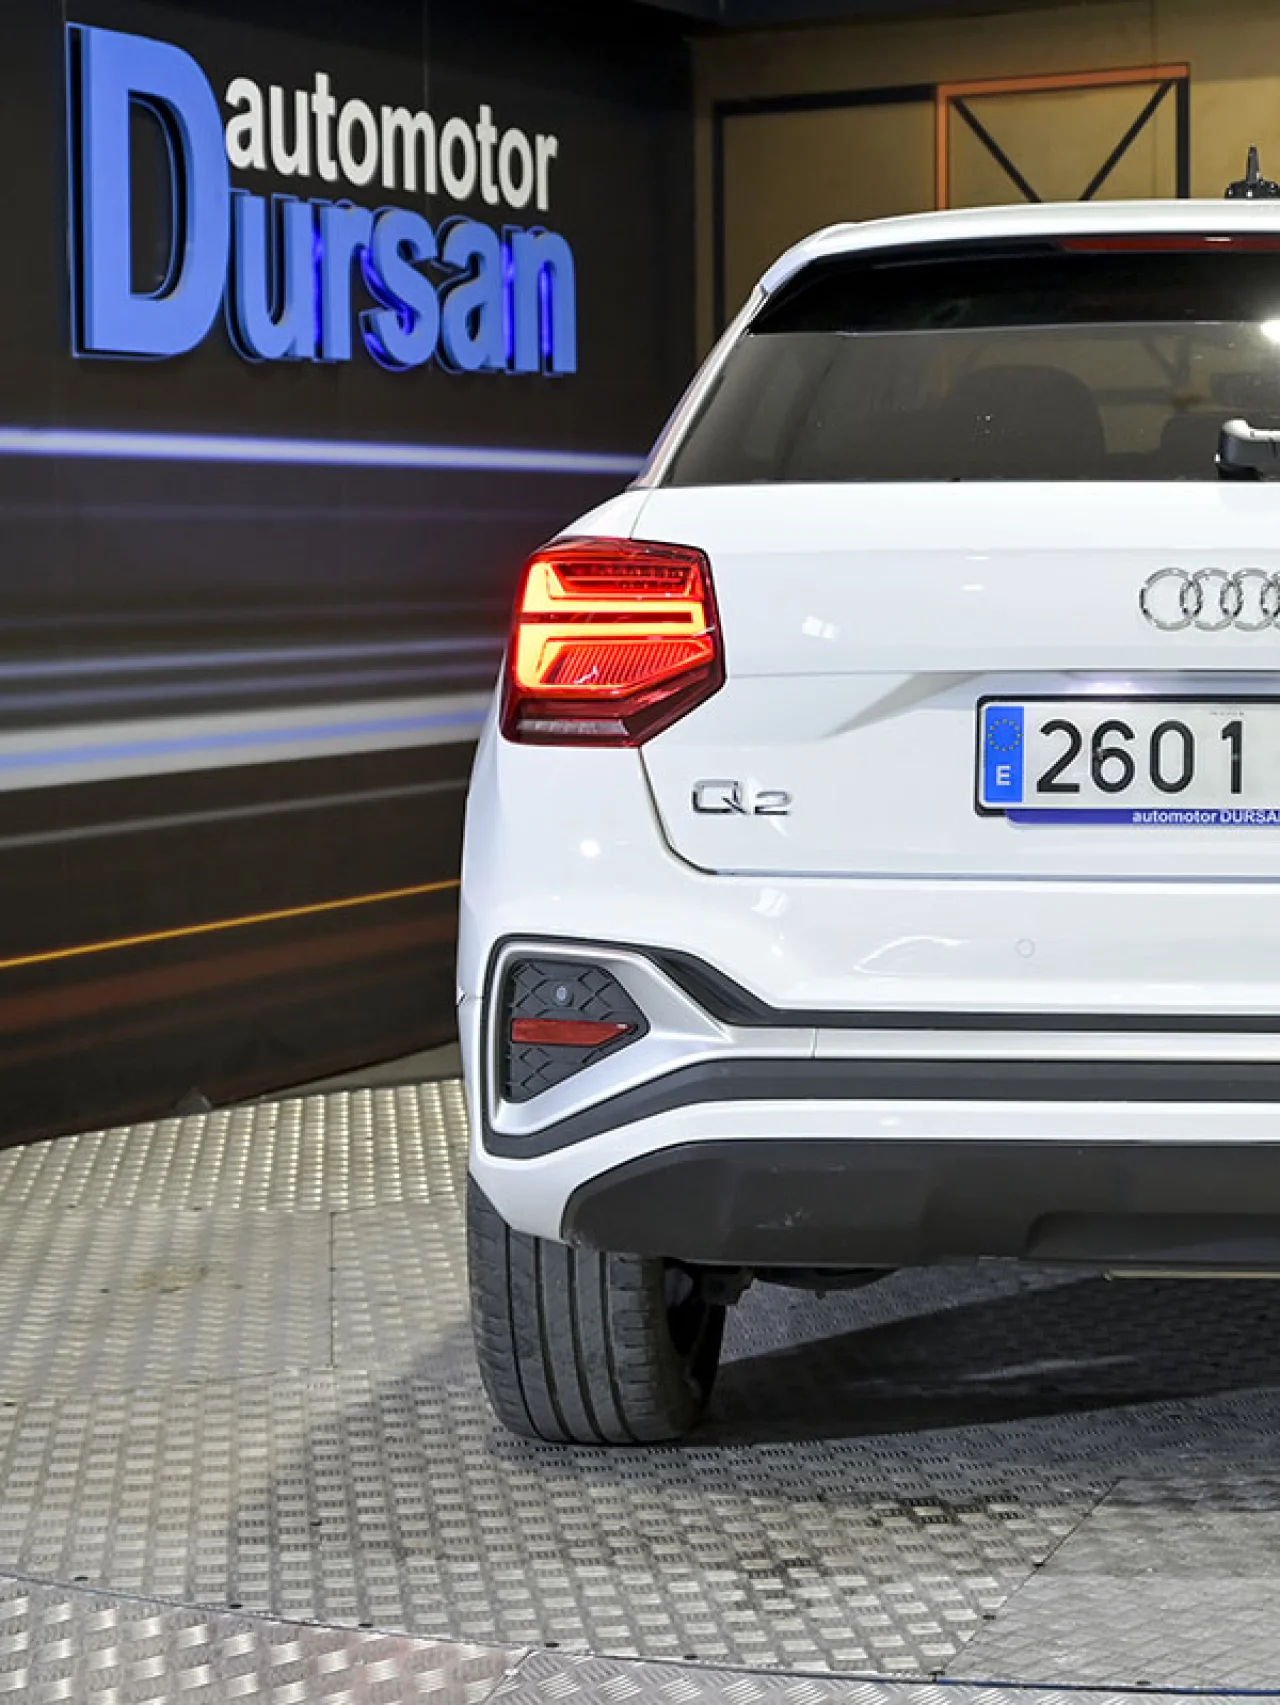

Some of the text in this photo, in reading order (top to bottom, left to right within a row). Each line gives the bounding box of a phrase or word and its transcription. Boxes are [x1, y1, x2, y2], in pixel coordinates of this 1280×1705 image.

[225, 72, 557, 210] automotor
[66, 21, 577, 376] Dursan
[996, 766, 1011, 786] E
[1036, 719, 1242, 794] 2601
[692, 778, 792, 815] Q2
